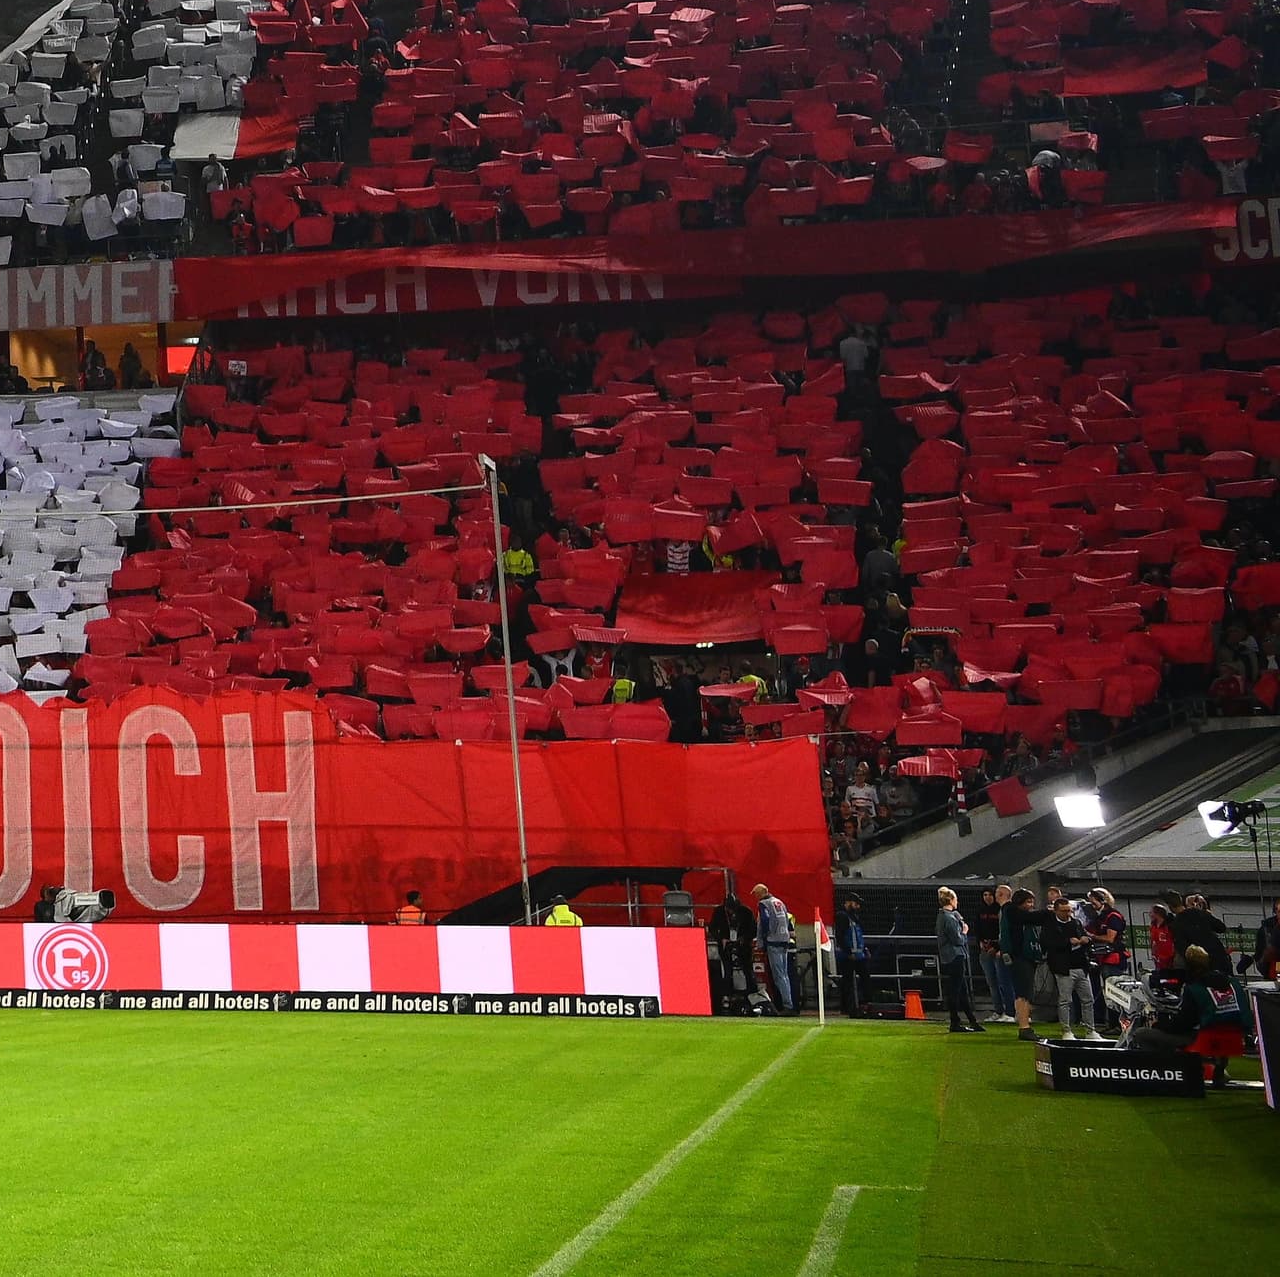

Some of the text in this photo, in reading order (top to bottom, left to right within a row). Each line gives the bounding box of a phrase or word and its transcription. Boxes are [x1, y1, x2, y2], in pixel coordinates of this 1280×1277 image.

[16, 992, 37, 1008] all
[42, 992, 96, 1009] hotels
[120, 993, 269, 1011] me and all hotels
[294, 994, 449, 1013] me and all hotels
[475, 995, 635, 1016] me and all hotels
[1069, 1066, 1184, 1082] BUNDESLIGA.DE
